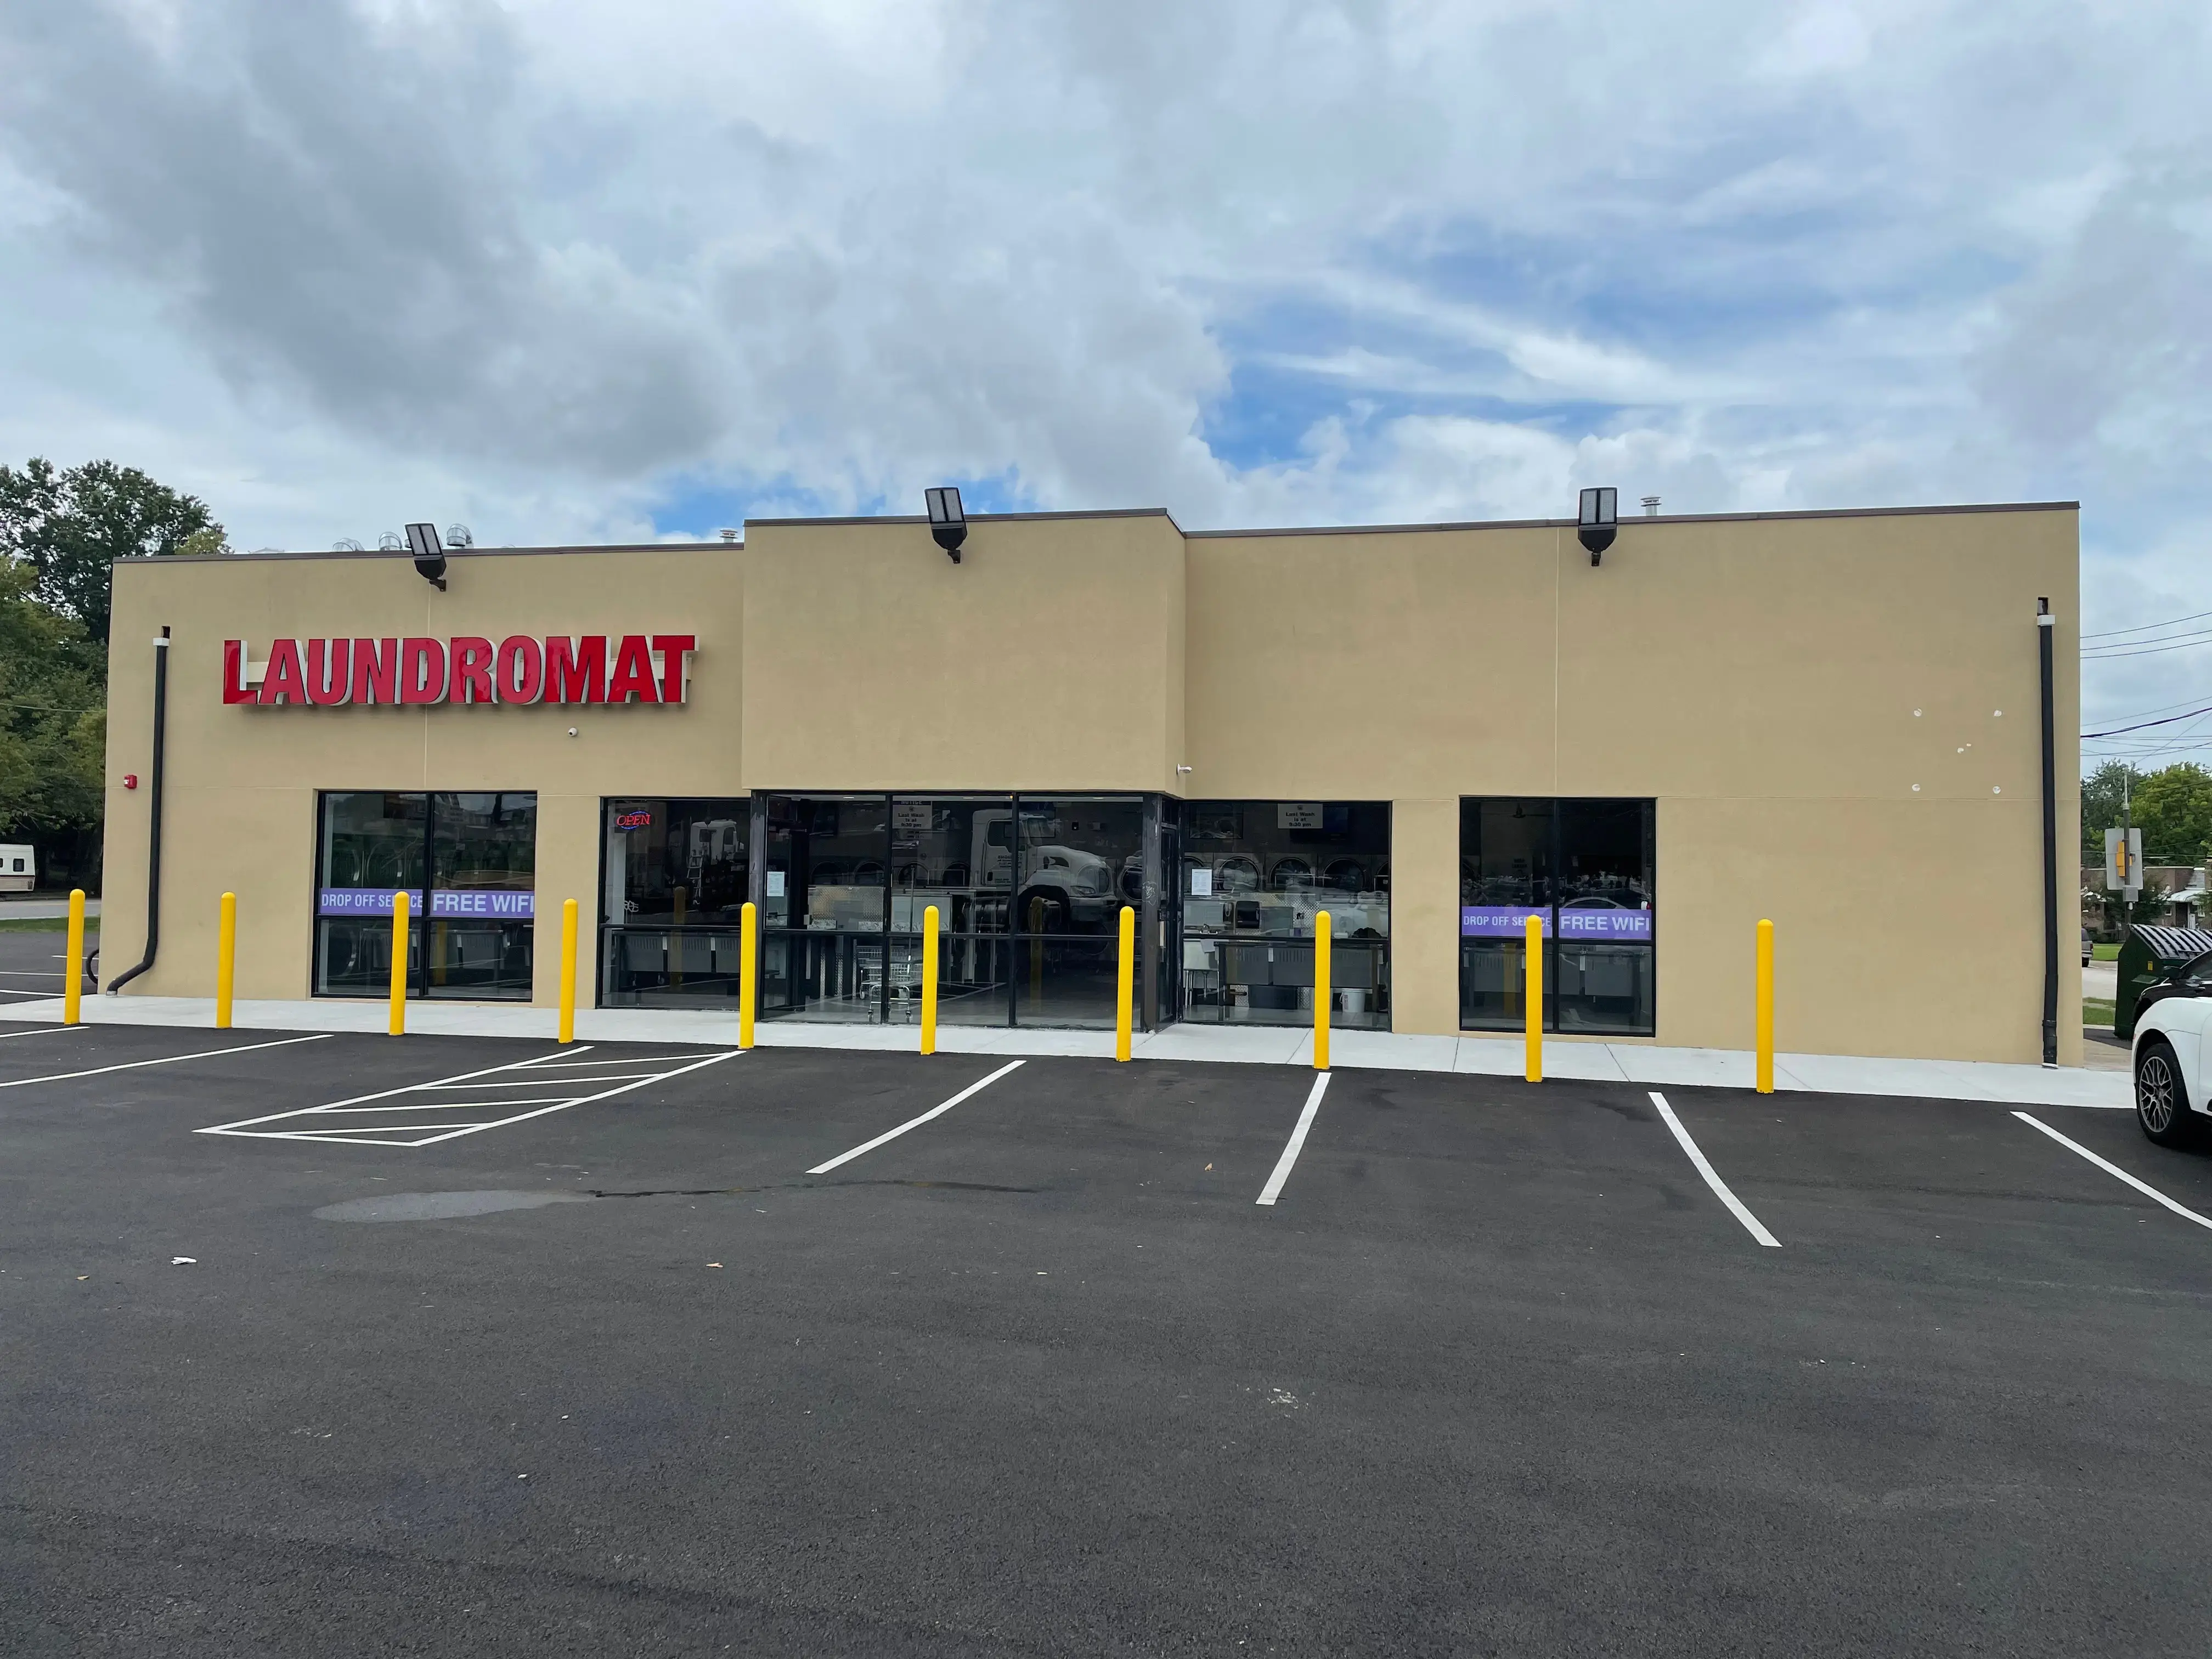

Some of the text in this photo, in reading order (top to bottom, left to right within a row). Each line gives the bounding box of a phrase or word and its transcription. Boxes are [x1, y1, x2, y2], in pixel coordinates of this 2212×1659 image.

[223, 635, 696, 705] LAUNDROMAT
[617, 814, 651, 826] OPEN
[321, 894, 423, 908] DROP OFF SECE
[433, 894, 534, 912] FREE WIFI
[1463, 916, 1551, 927] DROP OFF SECE
[1561, 916, 1650, 931] FREE WIFI
